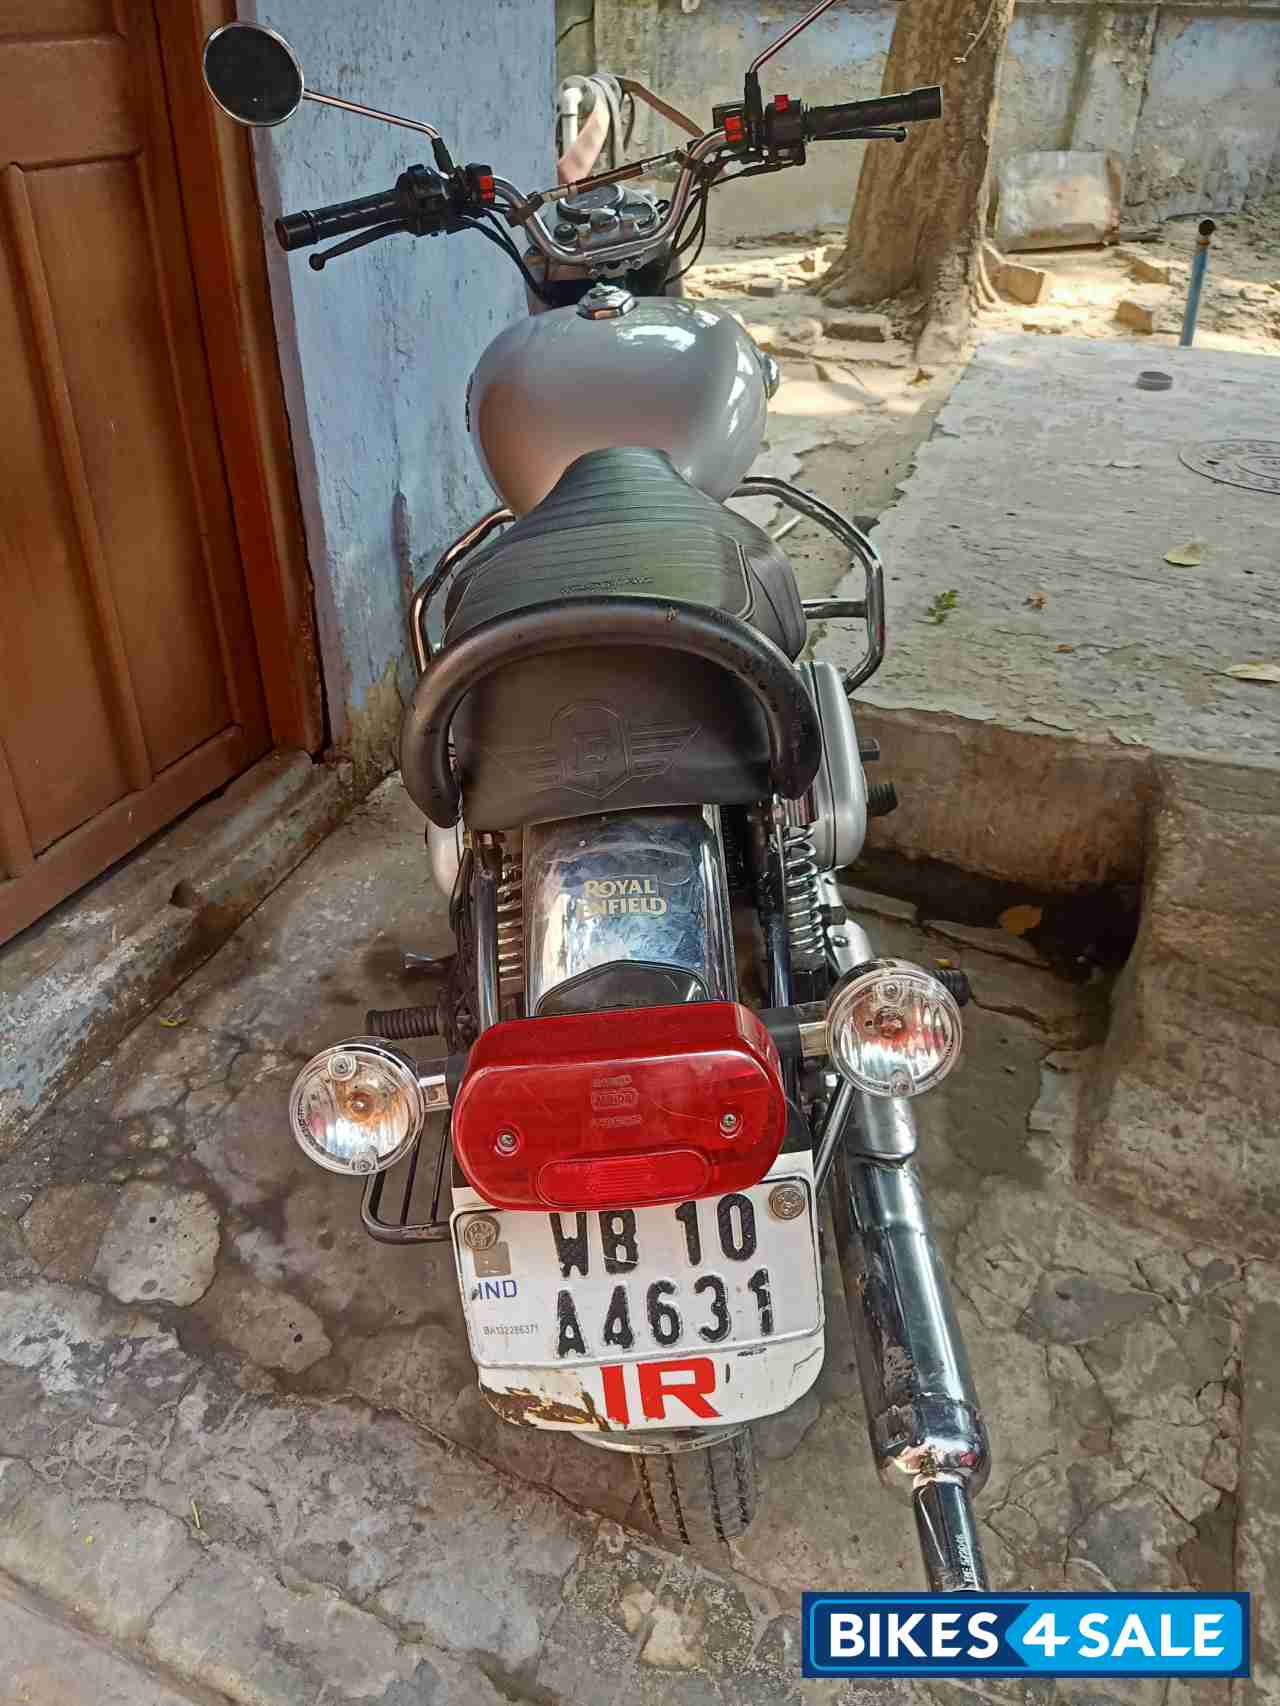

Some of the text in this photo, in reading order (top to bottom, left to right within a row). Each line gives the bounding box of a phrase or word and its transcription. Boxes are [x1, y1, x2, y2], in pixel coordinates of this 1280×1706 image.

[584, 879, 657, 897] ROYAL
[549, 1192, 757, 1278] WB 10
[478, 1280, 517, 1300] IND
